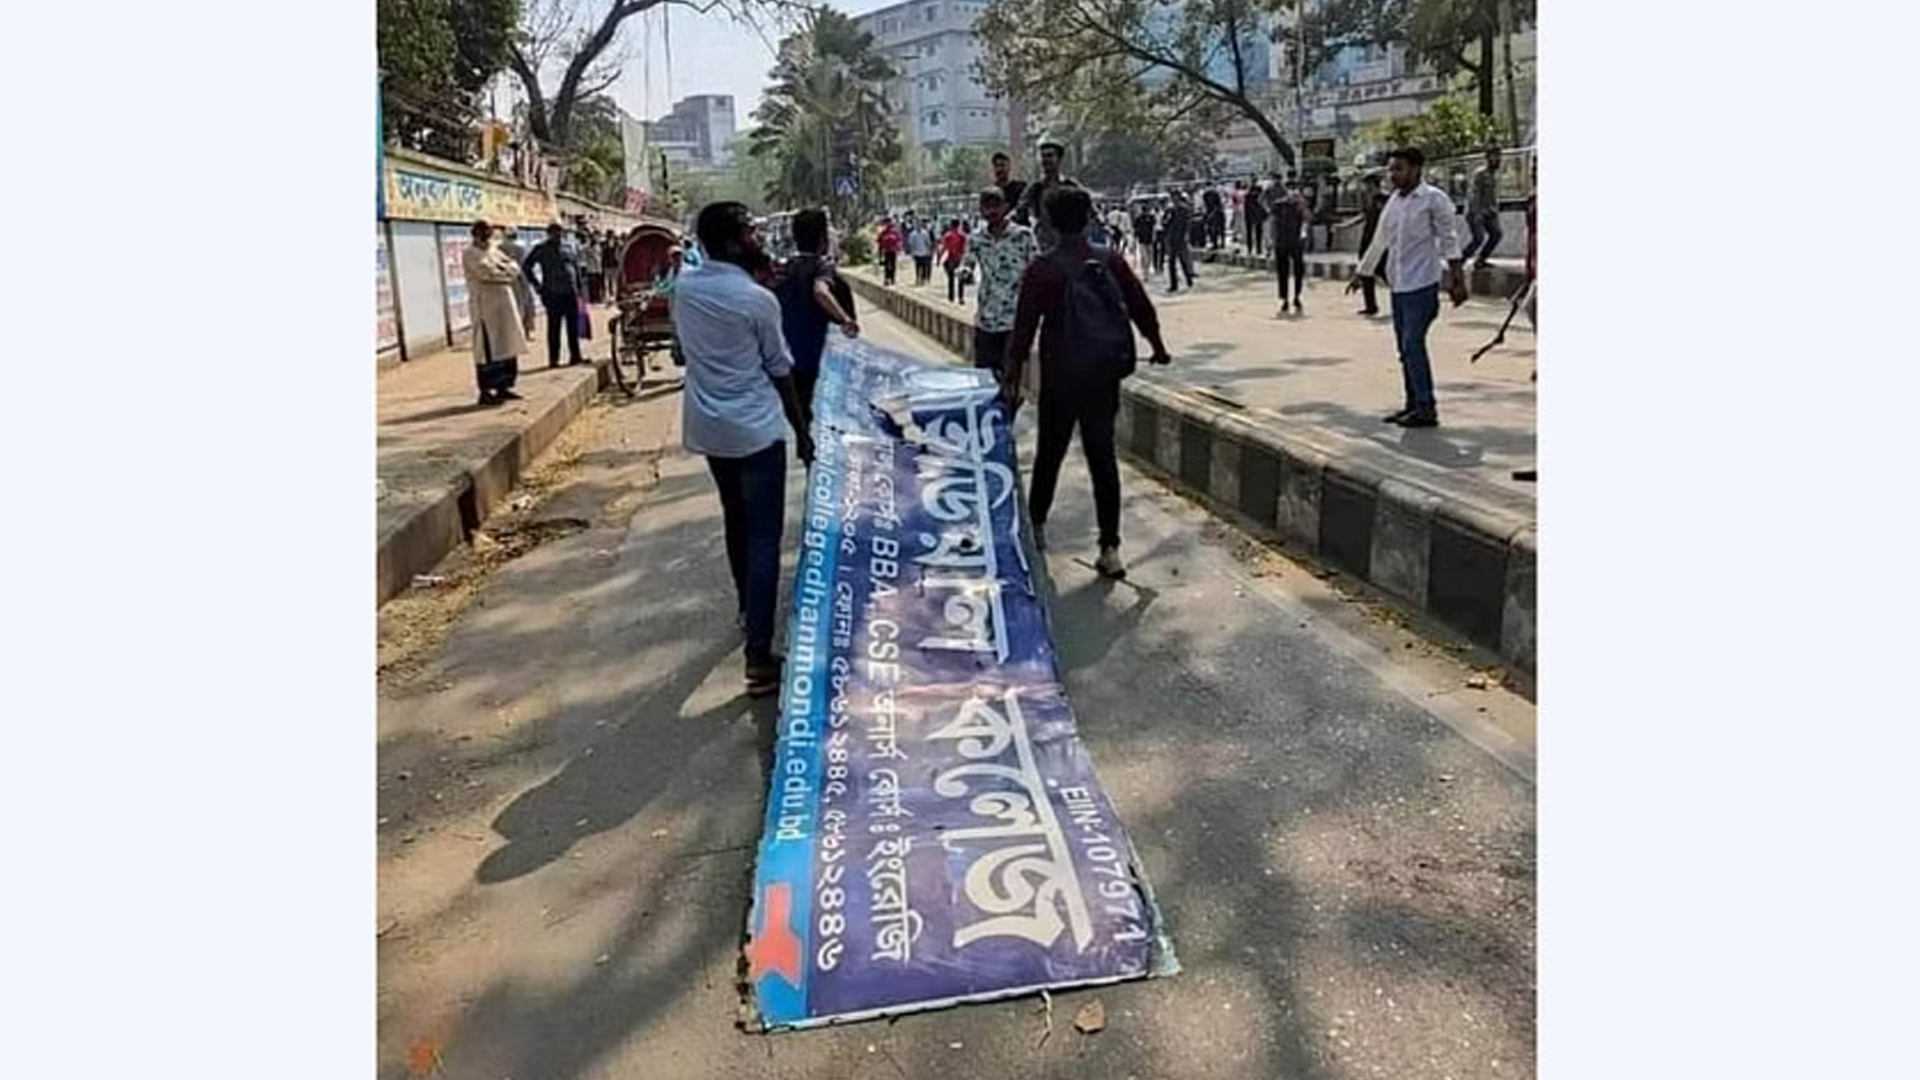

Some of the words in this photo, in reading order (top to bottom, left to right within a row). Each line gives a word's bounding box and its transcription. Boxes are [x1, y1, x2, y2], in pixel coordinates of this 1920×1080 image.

[868, 619, 900, 681] CSE
[868, 689, 908, 759] অনার্স
[926, 687, 1094, 954] কলেজ
[867, 837, 923, 966] ইংরেজি
